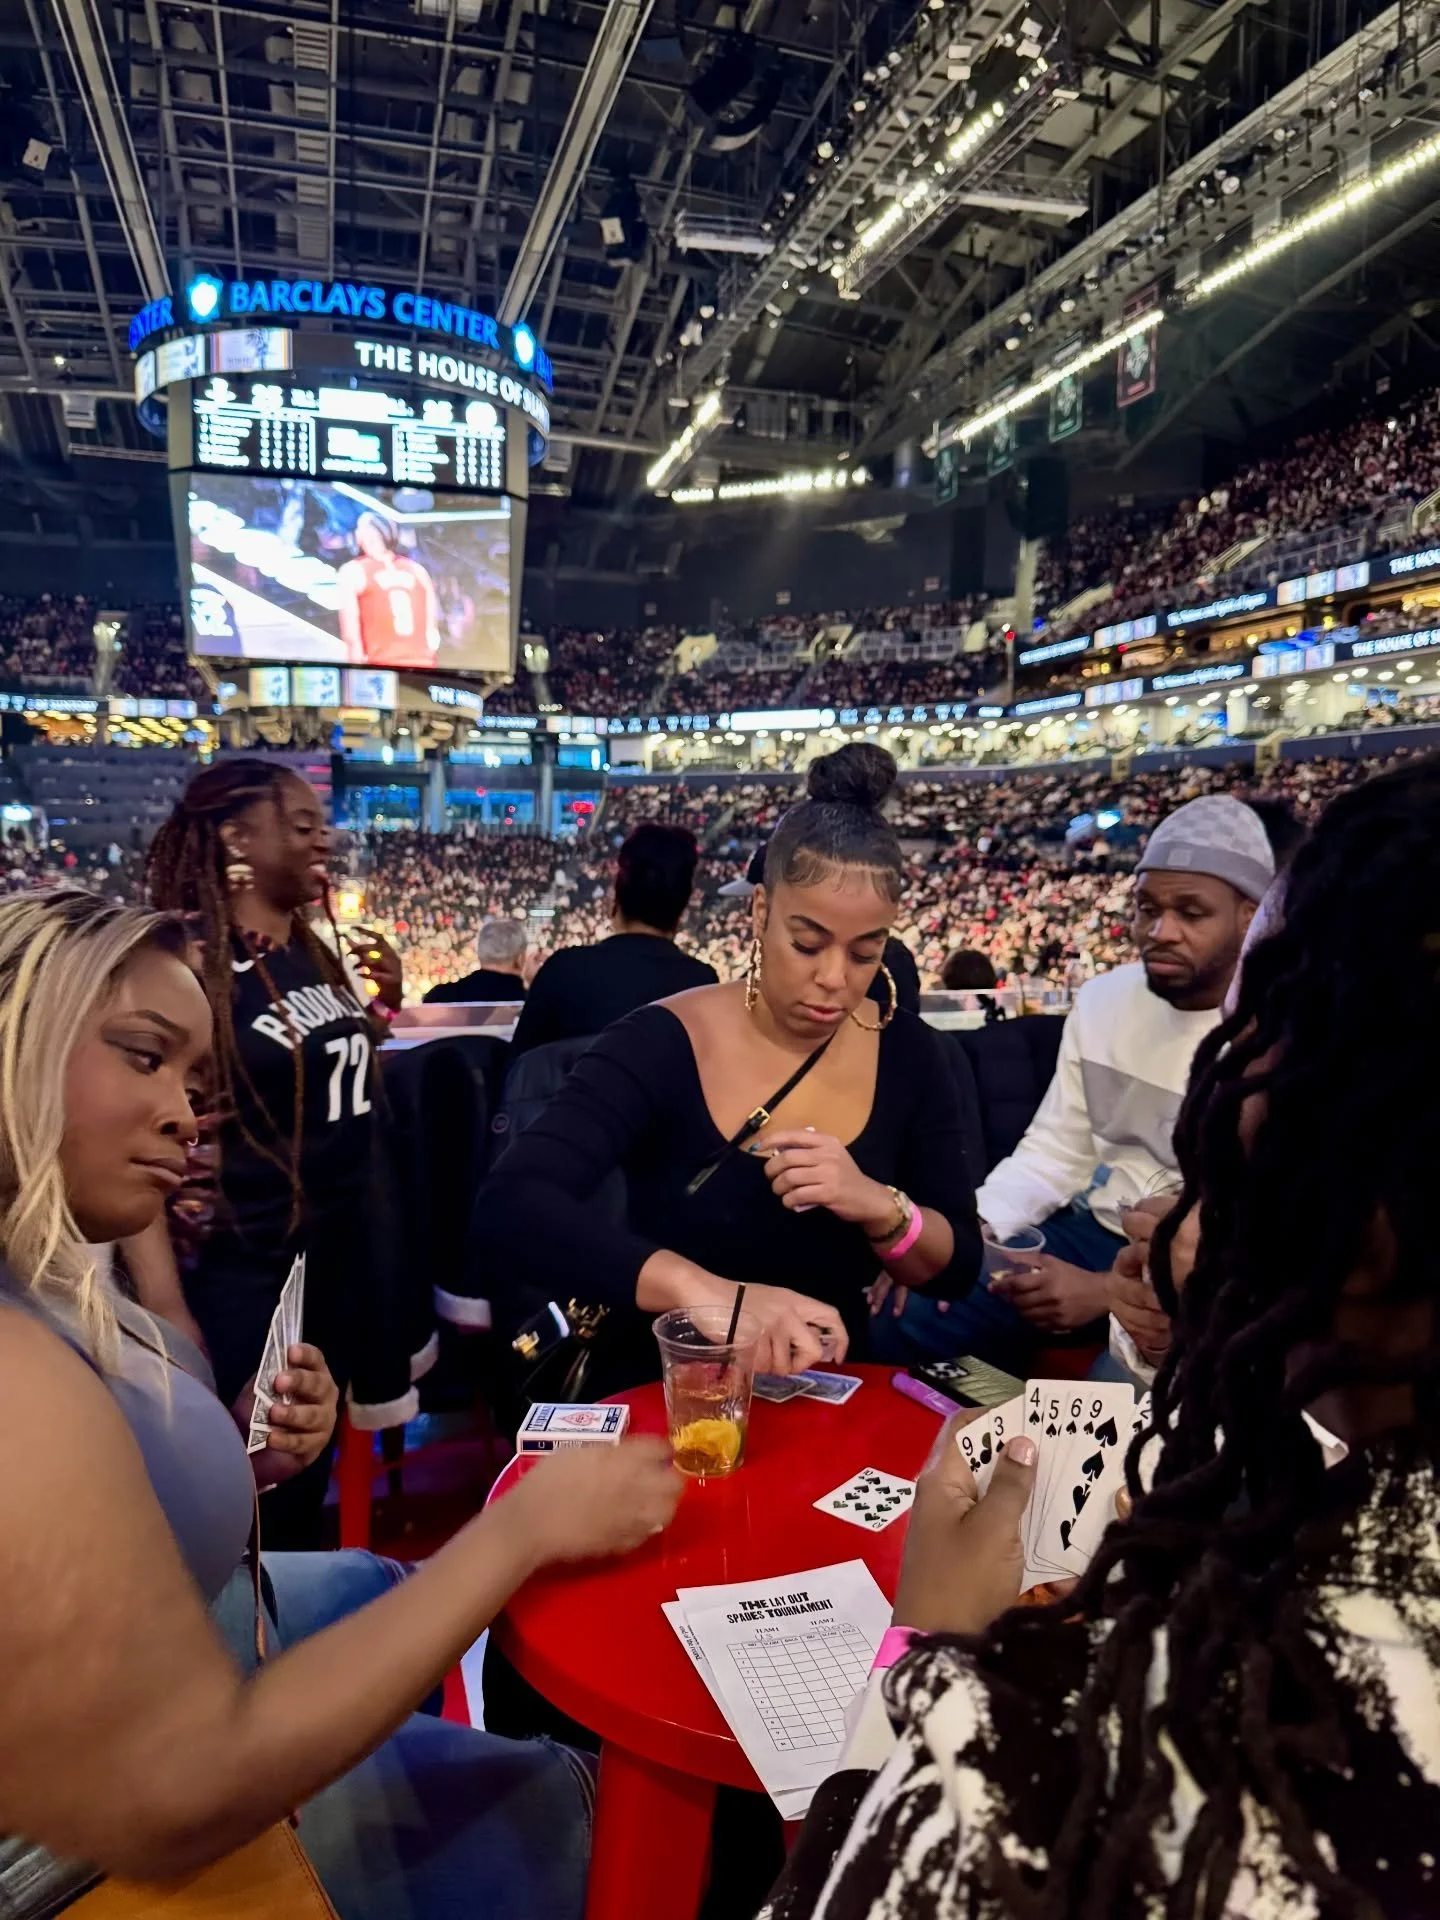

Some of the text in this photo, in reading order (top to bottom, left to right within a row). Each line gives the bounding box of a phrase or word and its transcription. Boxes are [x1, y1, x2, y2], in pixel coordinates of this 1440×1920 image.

[230, 280, 499, 349] BARCLAYS CENTER
[354, 341, 413, 373] THE
[418, 350, 498, 396] HOUSE
[500, 375, 523, 406] OF
[325, 1033, 371, 1122] 72
[1029, 1387, 1041, 1408] 4
[1070, 1398, 1083, 1418] 6
[1048, 1400, 1060, 1420] 5
[1089, 1399, 1103, 1419] 9
[993, 1416, 1004, 1437] 3
[961, 1436, 974, 1456] 9
[727, 1599, 834, 1623] SPADES TOURNAMENT
[739, 1592, 810, 1611] THE LAY OUT
